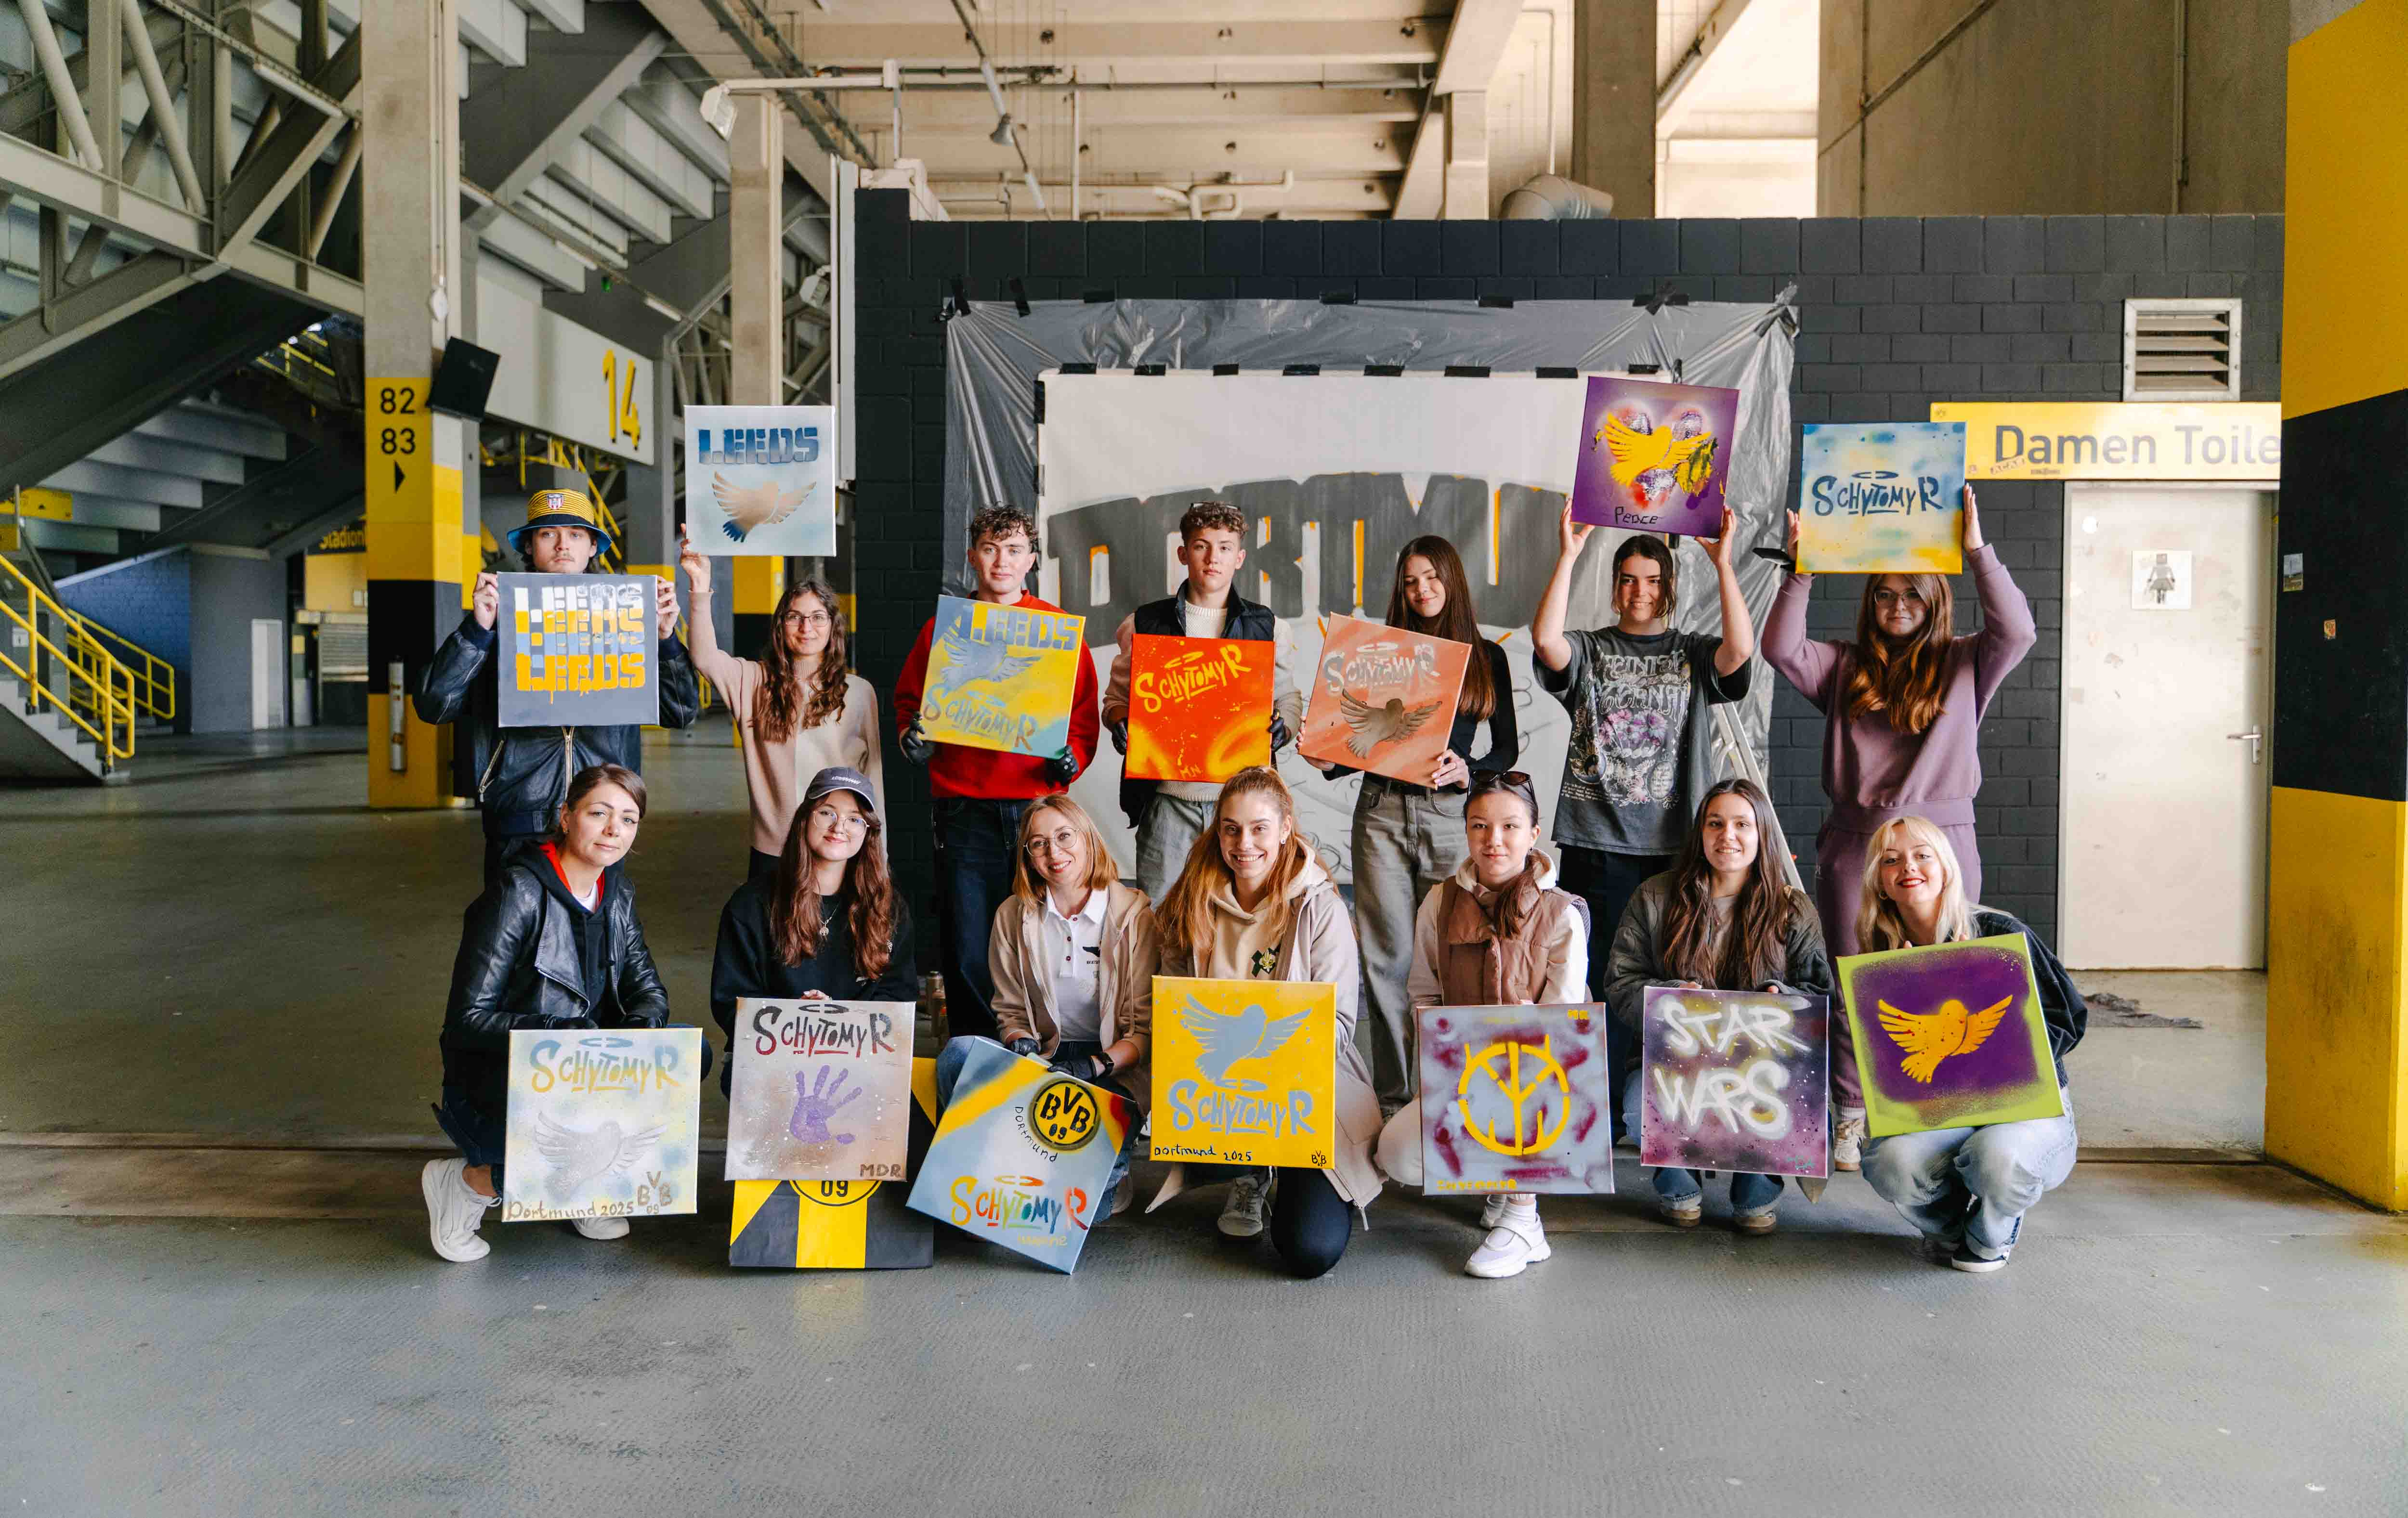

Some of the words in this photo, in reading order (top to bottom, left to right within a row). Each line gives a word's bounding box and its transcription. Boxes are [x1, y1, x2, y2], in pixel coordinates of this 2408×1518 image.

[380, 388, 416, 414] 82
[602, 349, 641, 451] 14
[380, 428, 416, 454] 83
[698, 427, 819, 465] LEEDS
[1995, 425, 2157, 465] Damen
[1615, 506, 1659, 524] Peace
[1812, 475, 1944, 516] SCHYTOMYR
[960, 604, 1080, 651] LEEDS
[516, 654, 646, 691] LEEDS
[1135, 644, 1252, 713] SCHYTOMYR
[923, 682, 1039, 752] SCHYTOMYR
[753, 1005, 895, 1058] SCHYTOMYR
[1656, 994, 1813, 1056] STAR
[529, 1039, 683, 1094] SCHYTOMYR
[1040, 1086, 1091, 1133] BVB
[1168, 1079, 1316, 1138] SCHYTOMYR
[1048, 1123, 1068, 1140] 09
[860, 1164, 902, 1178] MDR
[1223, 1151, 1253, 1162] 2025
[1311, 1150, 1327, 1165] BVB
[637, 1170, 673, 1207] BVB
[821, 1180, 849, 1197] 09
[950, 1175, 1089, 1234] SCHYTOMYR
[508, 1200, 596, 1220] Dortmund
[601, 1201, 634, 1216] 2025
